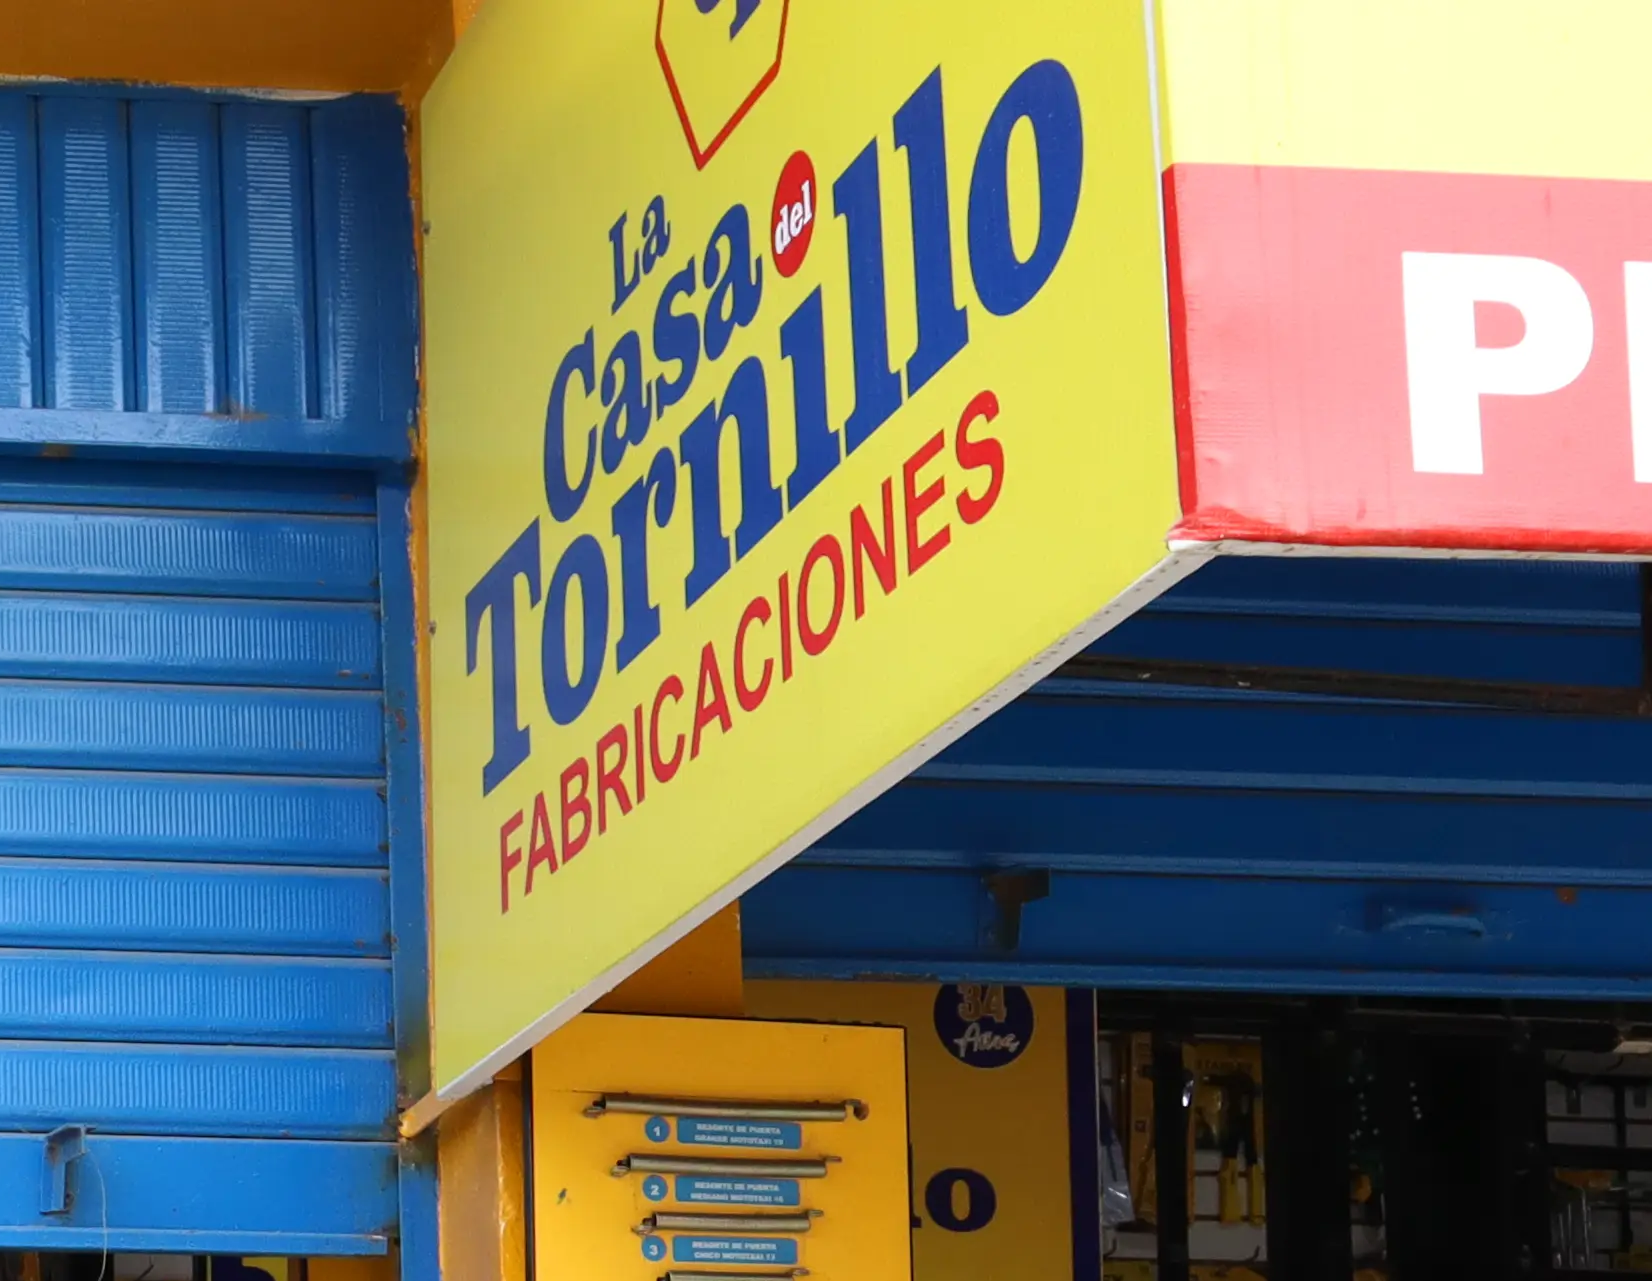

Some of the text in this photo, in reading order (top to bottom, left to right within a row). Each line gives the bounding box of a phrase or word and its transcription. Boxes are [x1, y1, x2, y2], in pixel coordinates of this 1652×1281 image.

[609, 195, 671, 315] La
[543, 180, 812, 522] Casa del
[464, 57, 1085, 798] Tornillo
[499, 388, 1007, 914] FABRICACIONES
[651, 1185, 660, 1196] 2
[653, 1125, 662, 1137] 1
[649, 1244, 659, 1256] 3
